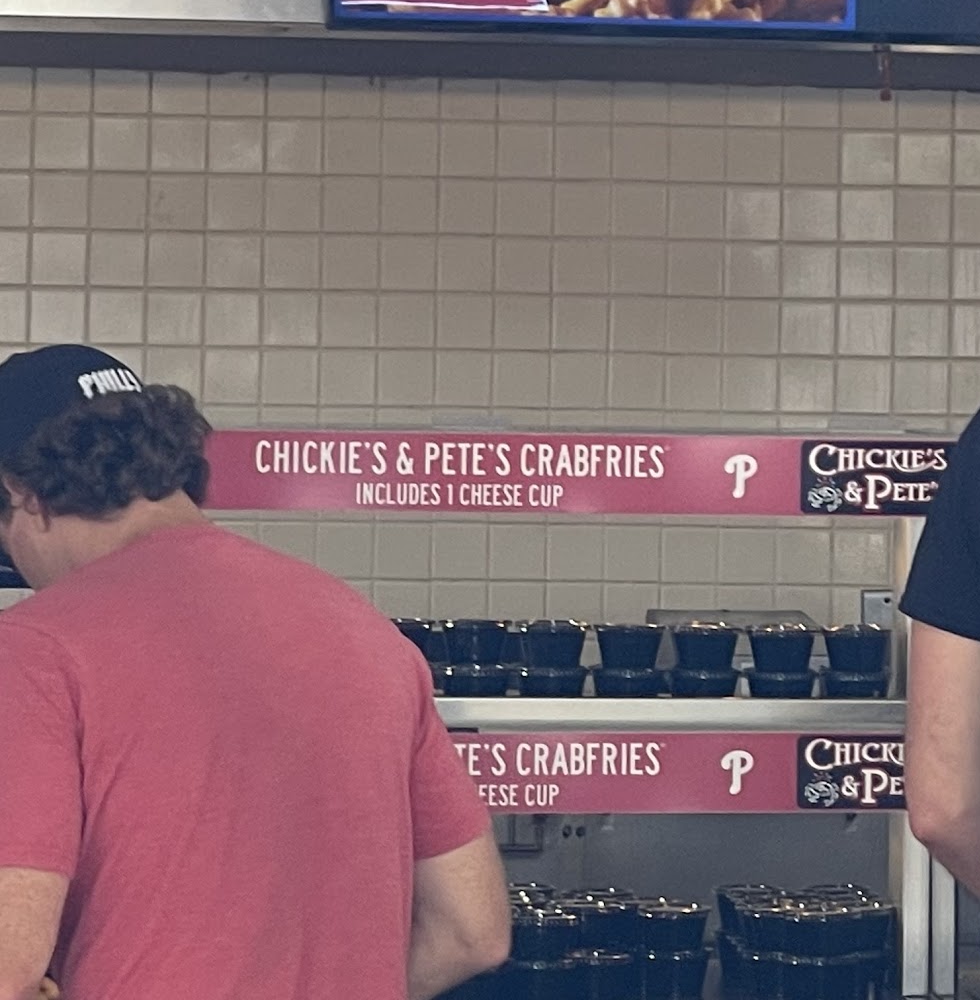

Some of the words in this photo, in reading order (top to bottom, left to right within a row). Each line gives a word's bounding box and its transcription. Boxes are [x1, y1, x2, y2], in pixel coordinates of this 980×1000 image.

[254, 440, 388, 475] CHICKIE'S
[395, 446, 415, 475] &
[424, 442, 511, 477] PETE'S
[520, 443, 666, 479] CRABFRIES
[355, 482, 443, 507] INCLUDES
[458, 484, 524, 507] CHEESE
[528, 485, 564, 508] CUP
[844, 481, 864, 504] &
[452, 742, 507, 777] TE'S
[516, 742, 662, 777] CRABFRIES
[804, 738, 905, 771] CHICKI
[478, 784, 519, 807] EESE
[524, 784, 560, 807] CUP
[841, 775, 860, 799] &
